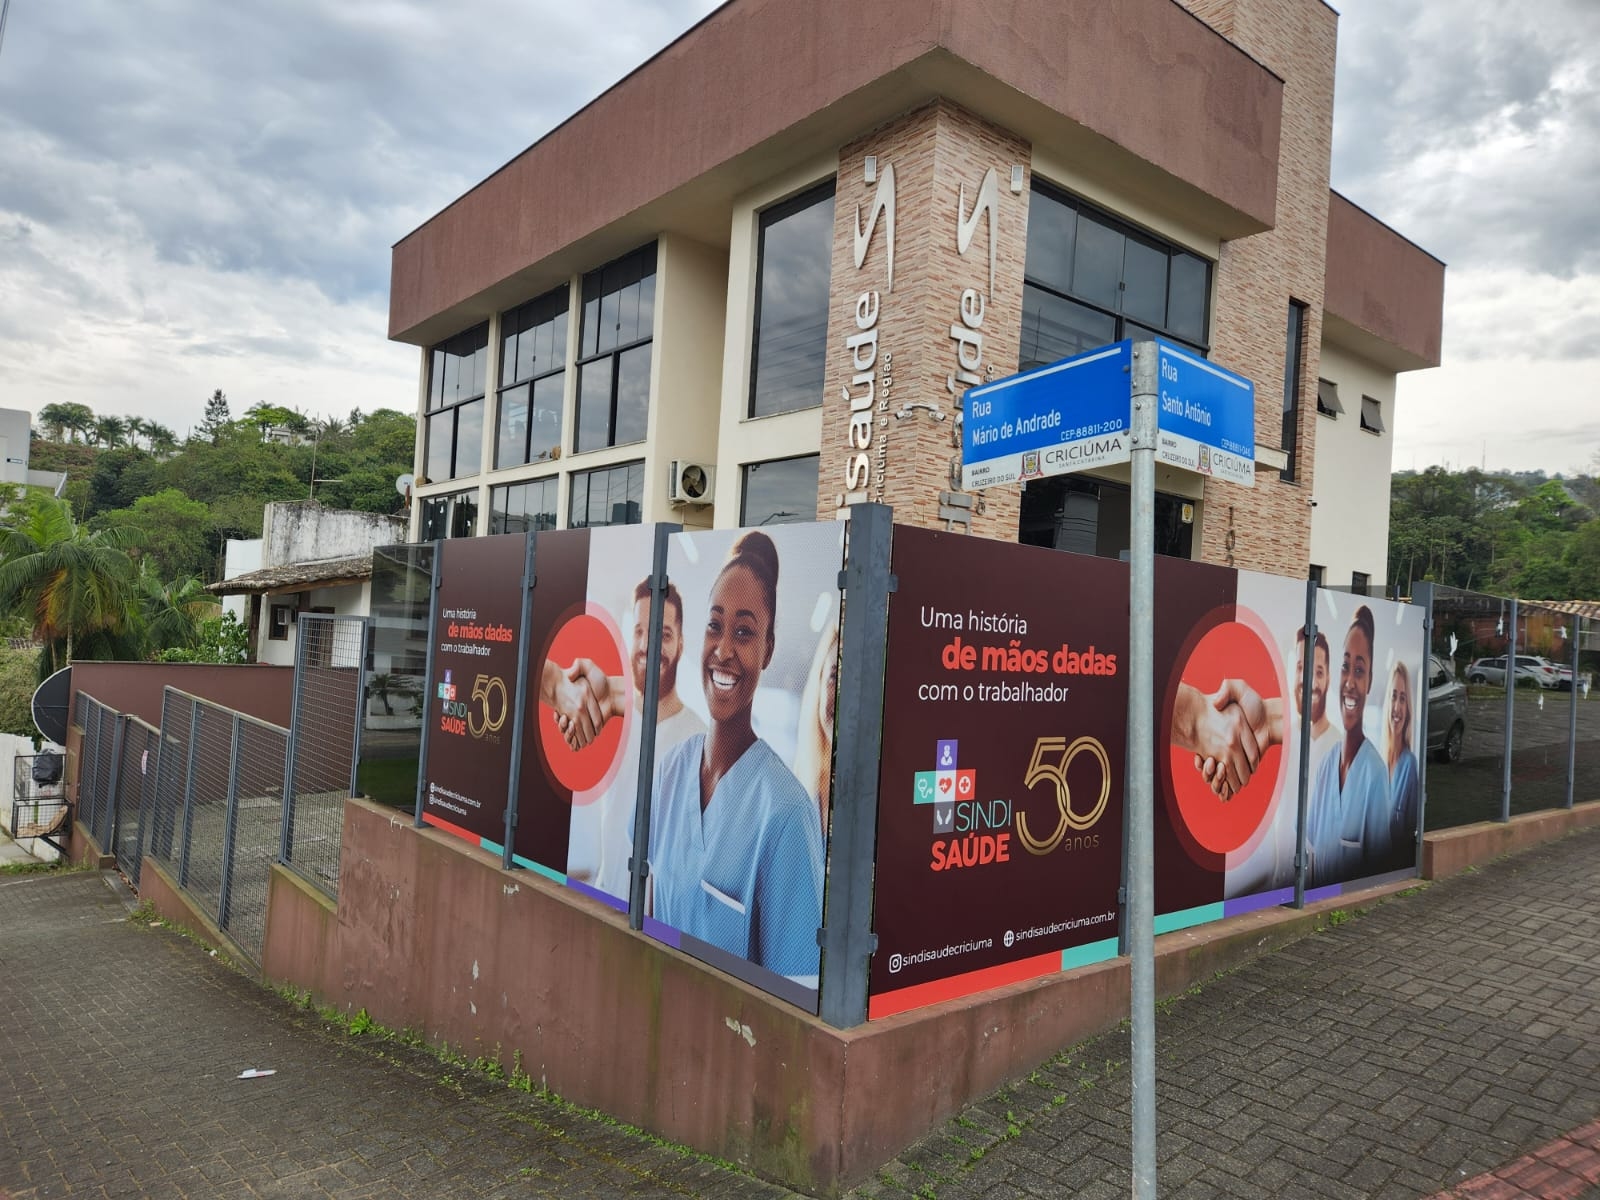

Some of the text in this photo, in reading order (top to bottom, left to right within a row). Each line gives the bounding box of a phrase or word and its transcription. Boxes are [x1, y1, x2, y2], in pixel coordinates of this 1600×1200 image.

[1162, 358, 1178, 382] Rua
[836, 288, 881, 520] isaúde
[972, 401, 991, 419] Rua
[1162, 390, 1211, 427] Santo Antônio
[880, 417, 889, 427] e
[972, 409, 1061, 447] Mário de Andrade
[1061, 418, 1122, 441] CEP:88811-200
[1045, 438, 1122, 464] CRICIÚMA
[1213, 452, 1251, 474] CRICIÚMA
[971, 466, 990, 477] BAIRRO
[971, 472, 1016, 488] CRUZEIRO DO SUL
[442, 608, 476, 620] Uma história
[920, 606, 1027, 635] Uma história
[448, 621, 512, 642] de mãos dadas
[441, 643, 491, 656] com o trabalhador
[942, 636, 1117, 676] de mãos dadas
[918, 681, 1069, 702] com o trabalhador
[468, 674, 507, 738] 50
[441, 715, 466, 736] SAÚDE
[1015, 735, 1111, 856] 50
[955, 799, 1012, 832] SINDI
[930, 832, 1011, 872] SAÚDE
[1064, 833, 1100, 852] anos
[1016, 910, 1116, 942] sindisaudecriciuma.com.br
[902, 936, 993, 967] sindisaudecriciuma
